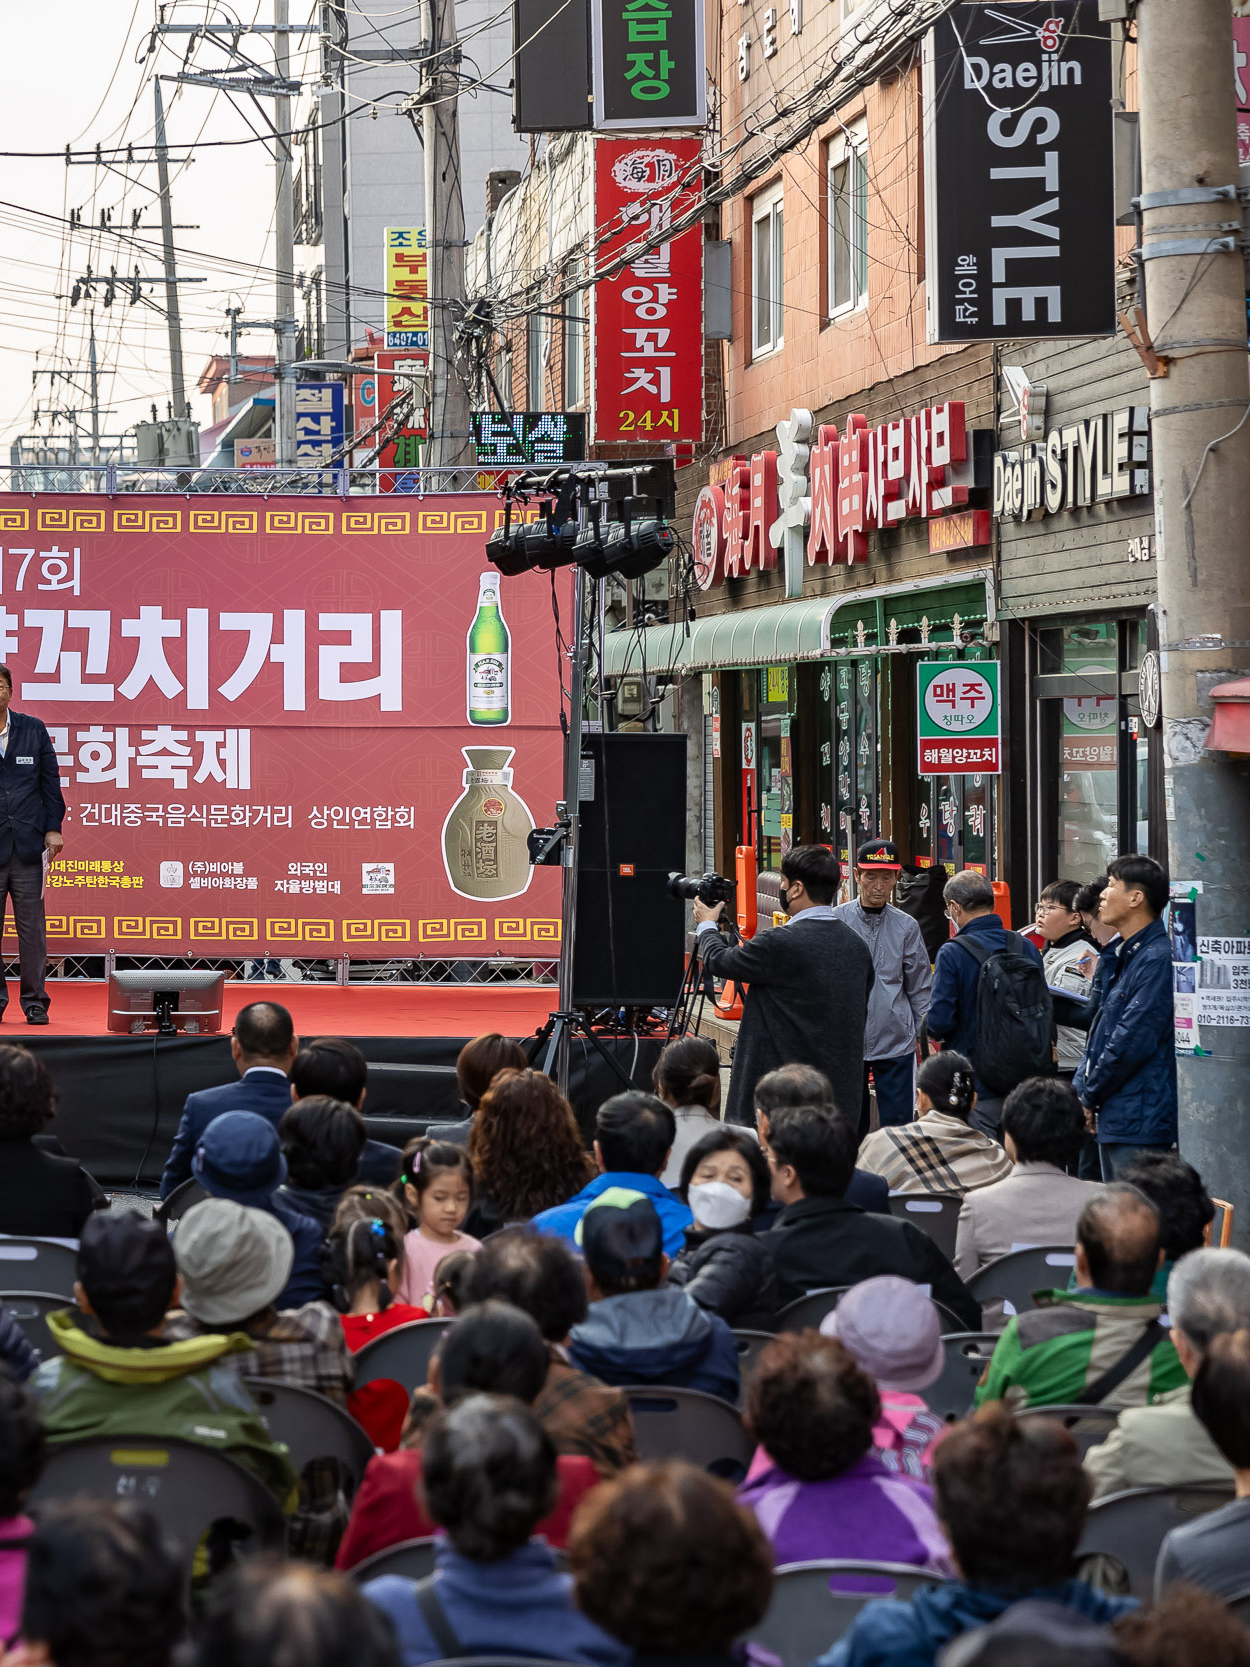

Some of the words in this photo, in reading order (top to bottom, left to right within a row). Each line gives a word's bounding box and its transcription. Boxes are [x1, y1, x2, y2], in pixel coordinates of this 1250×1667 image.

[622, 0, 675, 100] 습장
[963, 53, 1082, 92] Daejin
[623, 158, 674, 182] 海月
[987, 106, 1062, 325] STYLE
[391, 252, 428, 329] 부동산
[954, 254, 979, 324] 헤어샵
[618, 409, 680, 433] 24시
[866, 401, 967, 528] 샤브샤브
[993, 446, 1048, 521] Daejin
[1046, 411, 1130, 514] STYLE
[932, 682, 986, 709] 맥주
[942, 714, 977, 727] 칭따오
[820, 665, 831, 833] 양꼬치
[858, 661, 871, 831] 탕수육
[924, 748, 996, 765] 해월양꼬치
[79, 803, 293, 829] 건대중국음식문화거리
[307, 804, 416, 830] 상인연합회
[188, 860, 245, 875] (주)비아블
[287, 862, 328, 877] 외국인
[274, 878, 342, 895] 자율방범대
